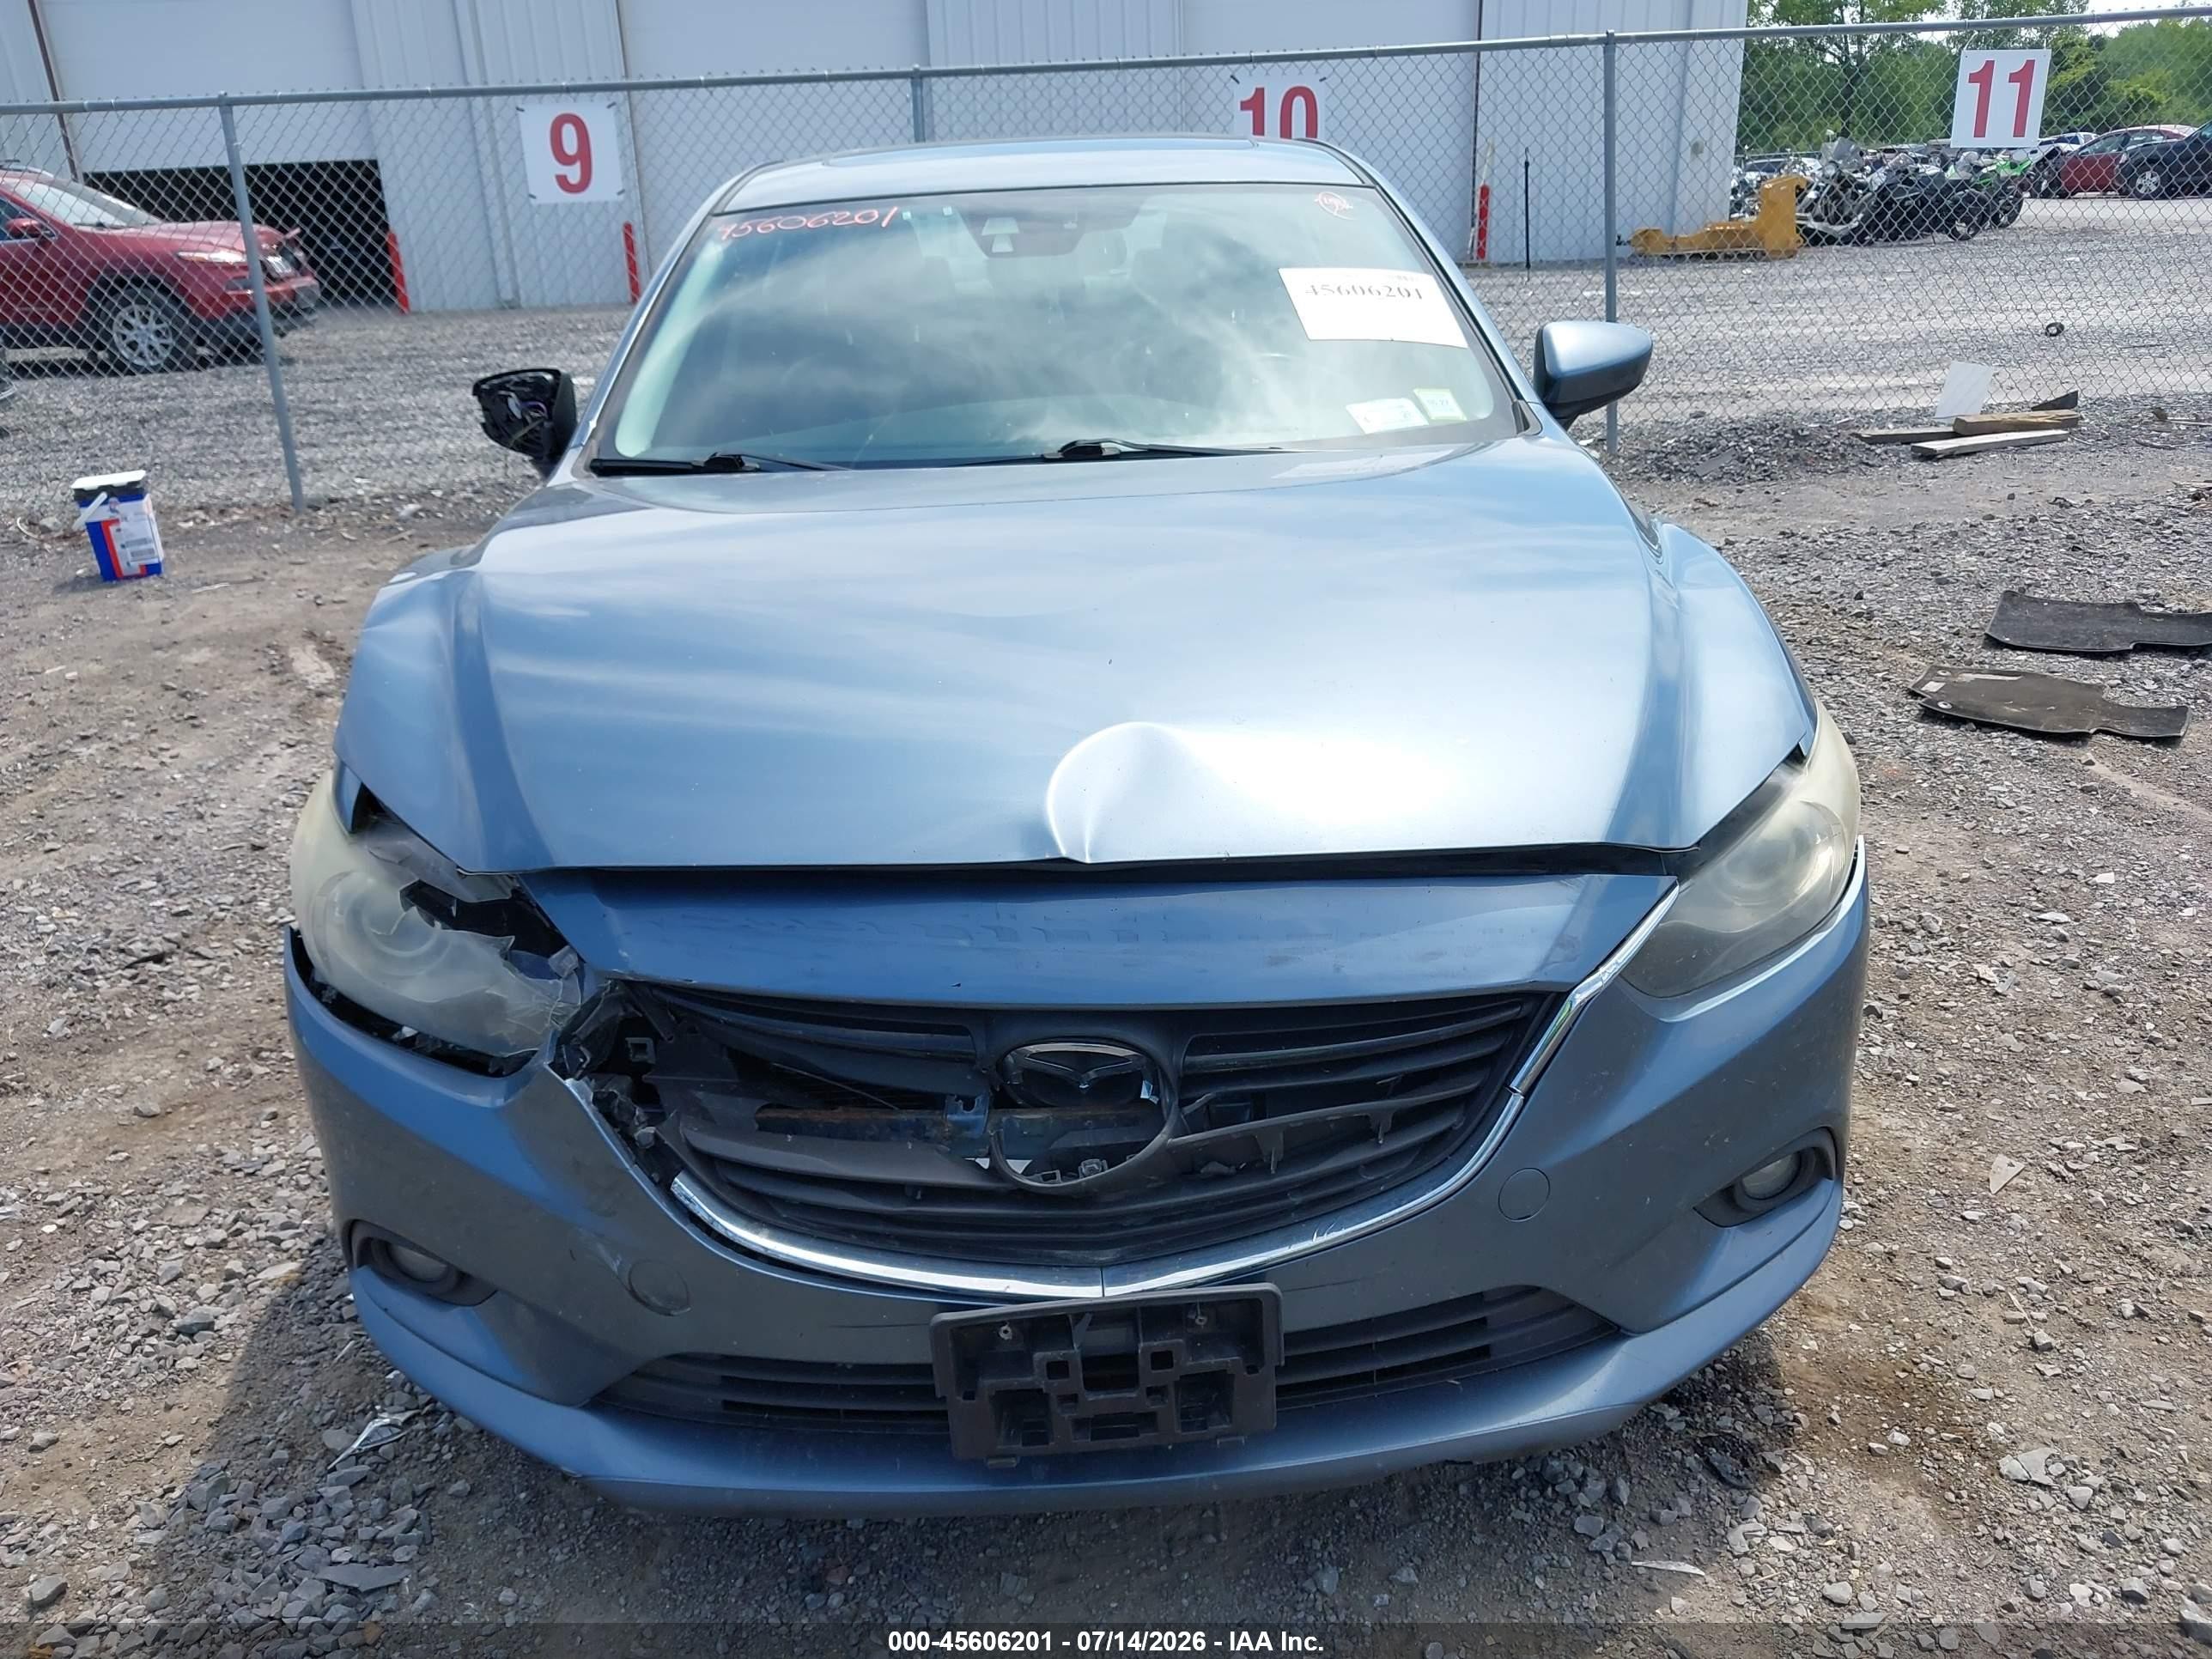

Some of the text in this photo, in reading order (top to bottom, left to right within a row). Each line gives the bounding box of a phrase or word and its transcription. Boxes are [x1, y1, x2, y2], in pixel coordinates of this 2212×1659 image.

[1240, 86, 1318, 139] 10
[1968, 59, 2036, 138] 11
[550, 112, 592, 193] 9
[1305, 284, 1423, 300] 45606201
